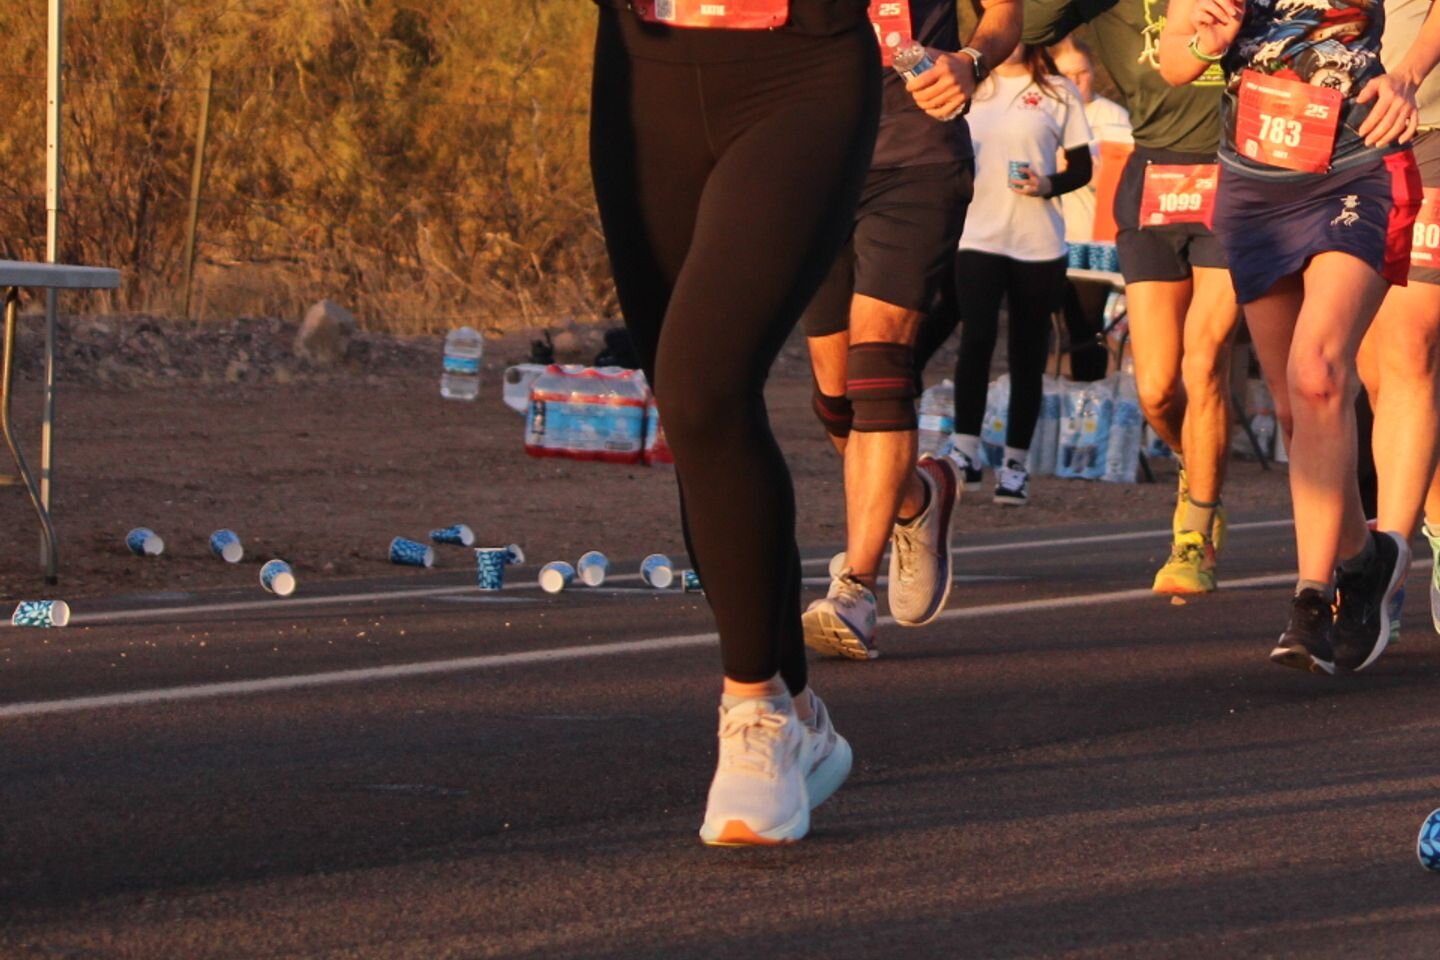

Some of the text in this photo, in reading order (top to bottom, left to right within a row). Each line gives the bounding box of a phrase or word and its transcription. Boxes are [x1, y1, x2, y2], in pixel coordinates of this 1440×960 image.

[879, 2, 901, 17] 25
[1304, 103, 1329, 119] 25
[1258, 113, 1303, 147] 783
[1158, 192, 1202, 212] 1099
